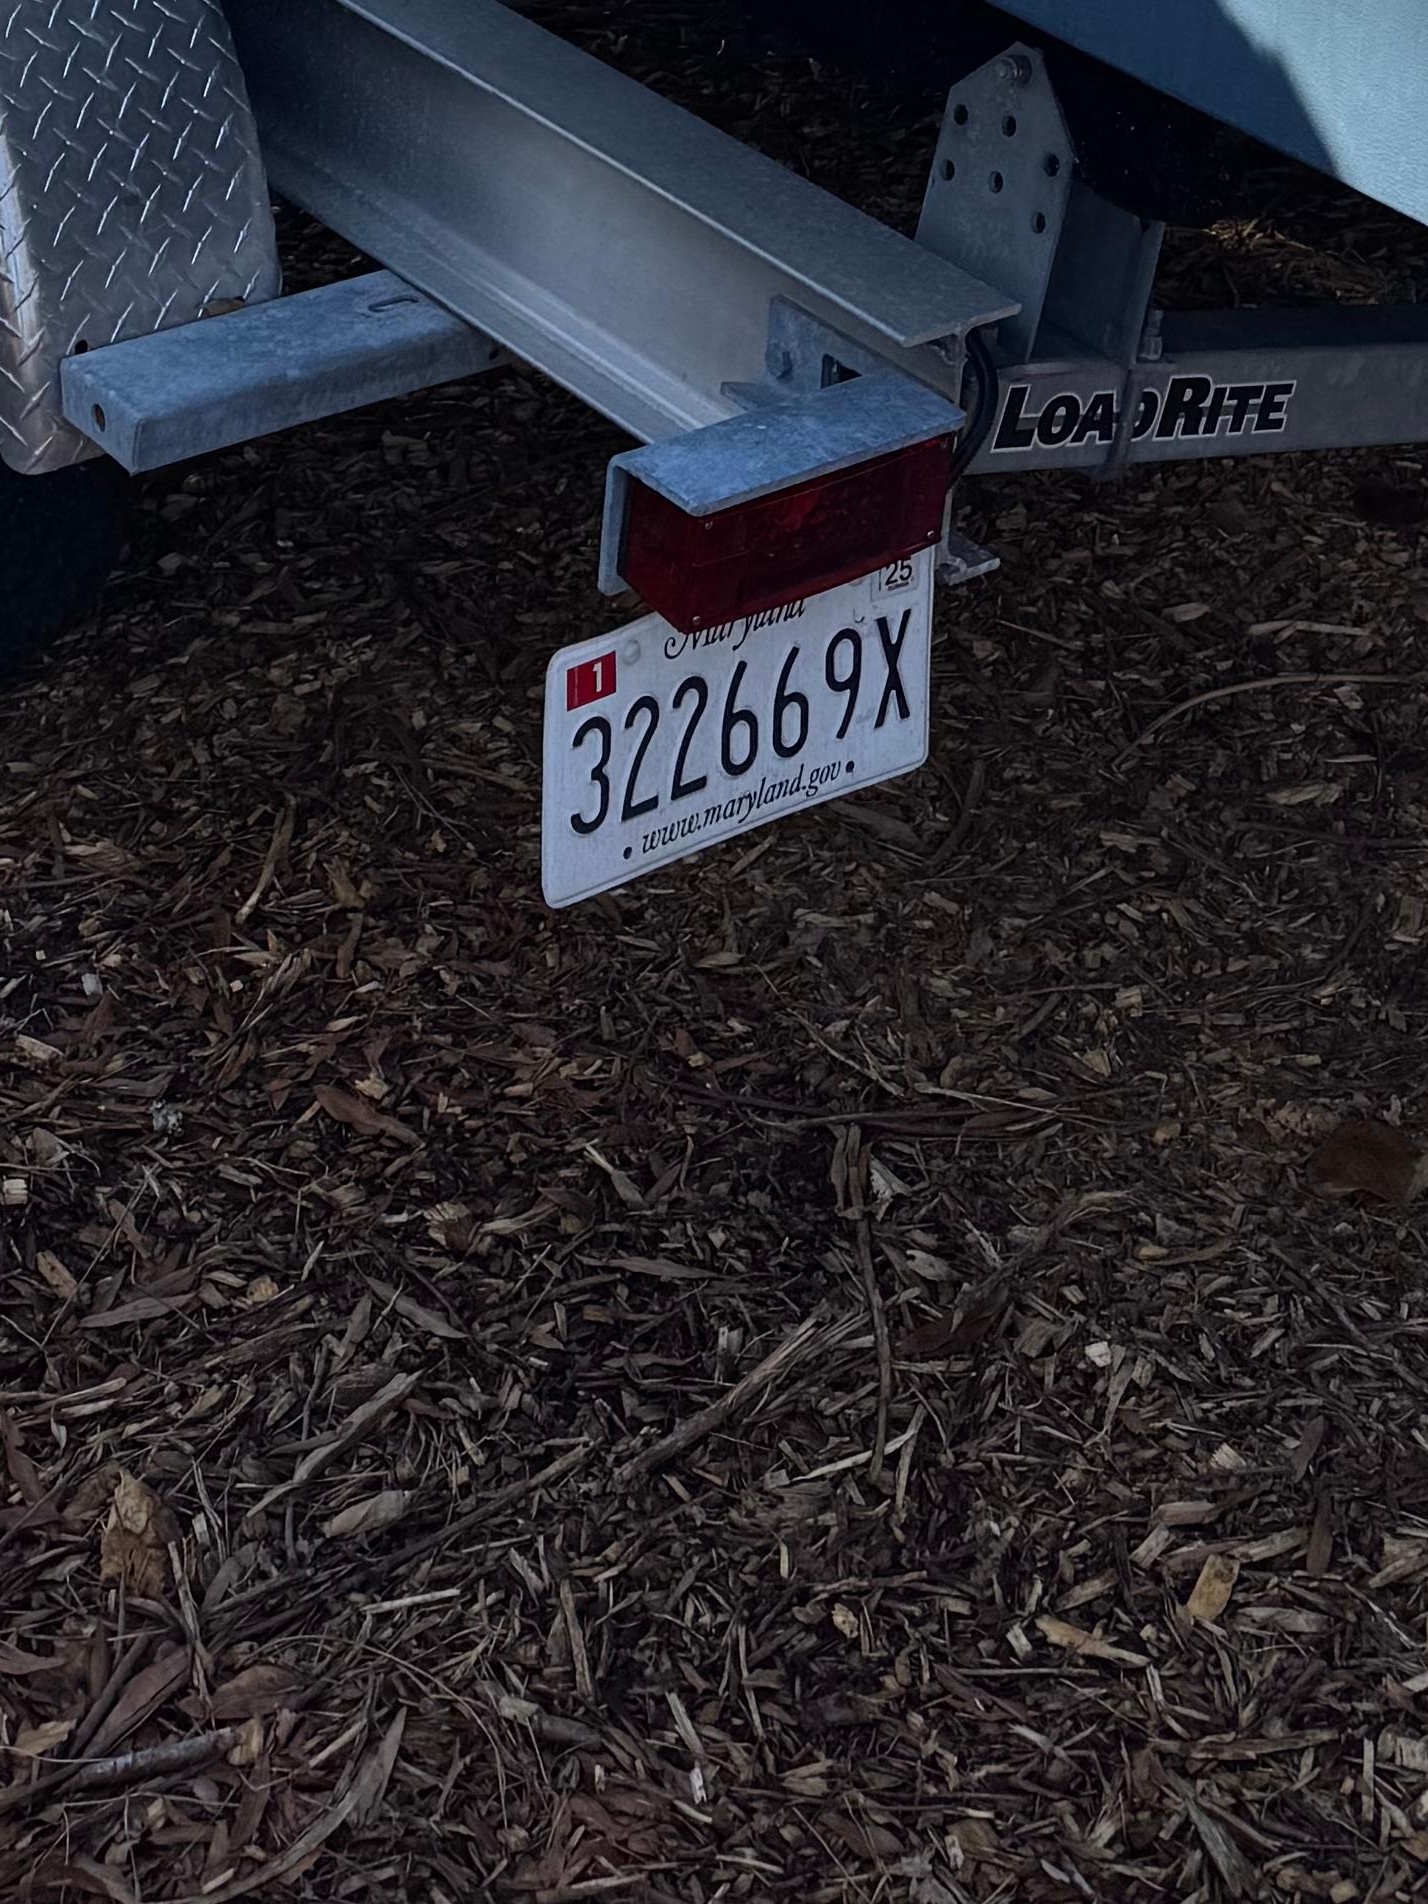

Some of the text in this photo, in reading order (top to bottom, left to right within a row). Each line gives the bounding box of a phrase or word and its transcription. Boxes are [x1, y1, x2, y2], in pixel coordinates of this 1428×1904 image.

[885, 559, 913, 586] 25
[592, 661, 603, 693] 1
[570, 608, 911, 835] 322669X
[642, 760, 842, 854] www.maryland.gov
